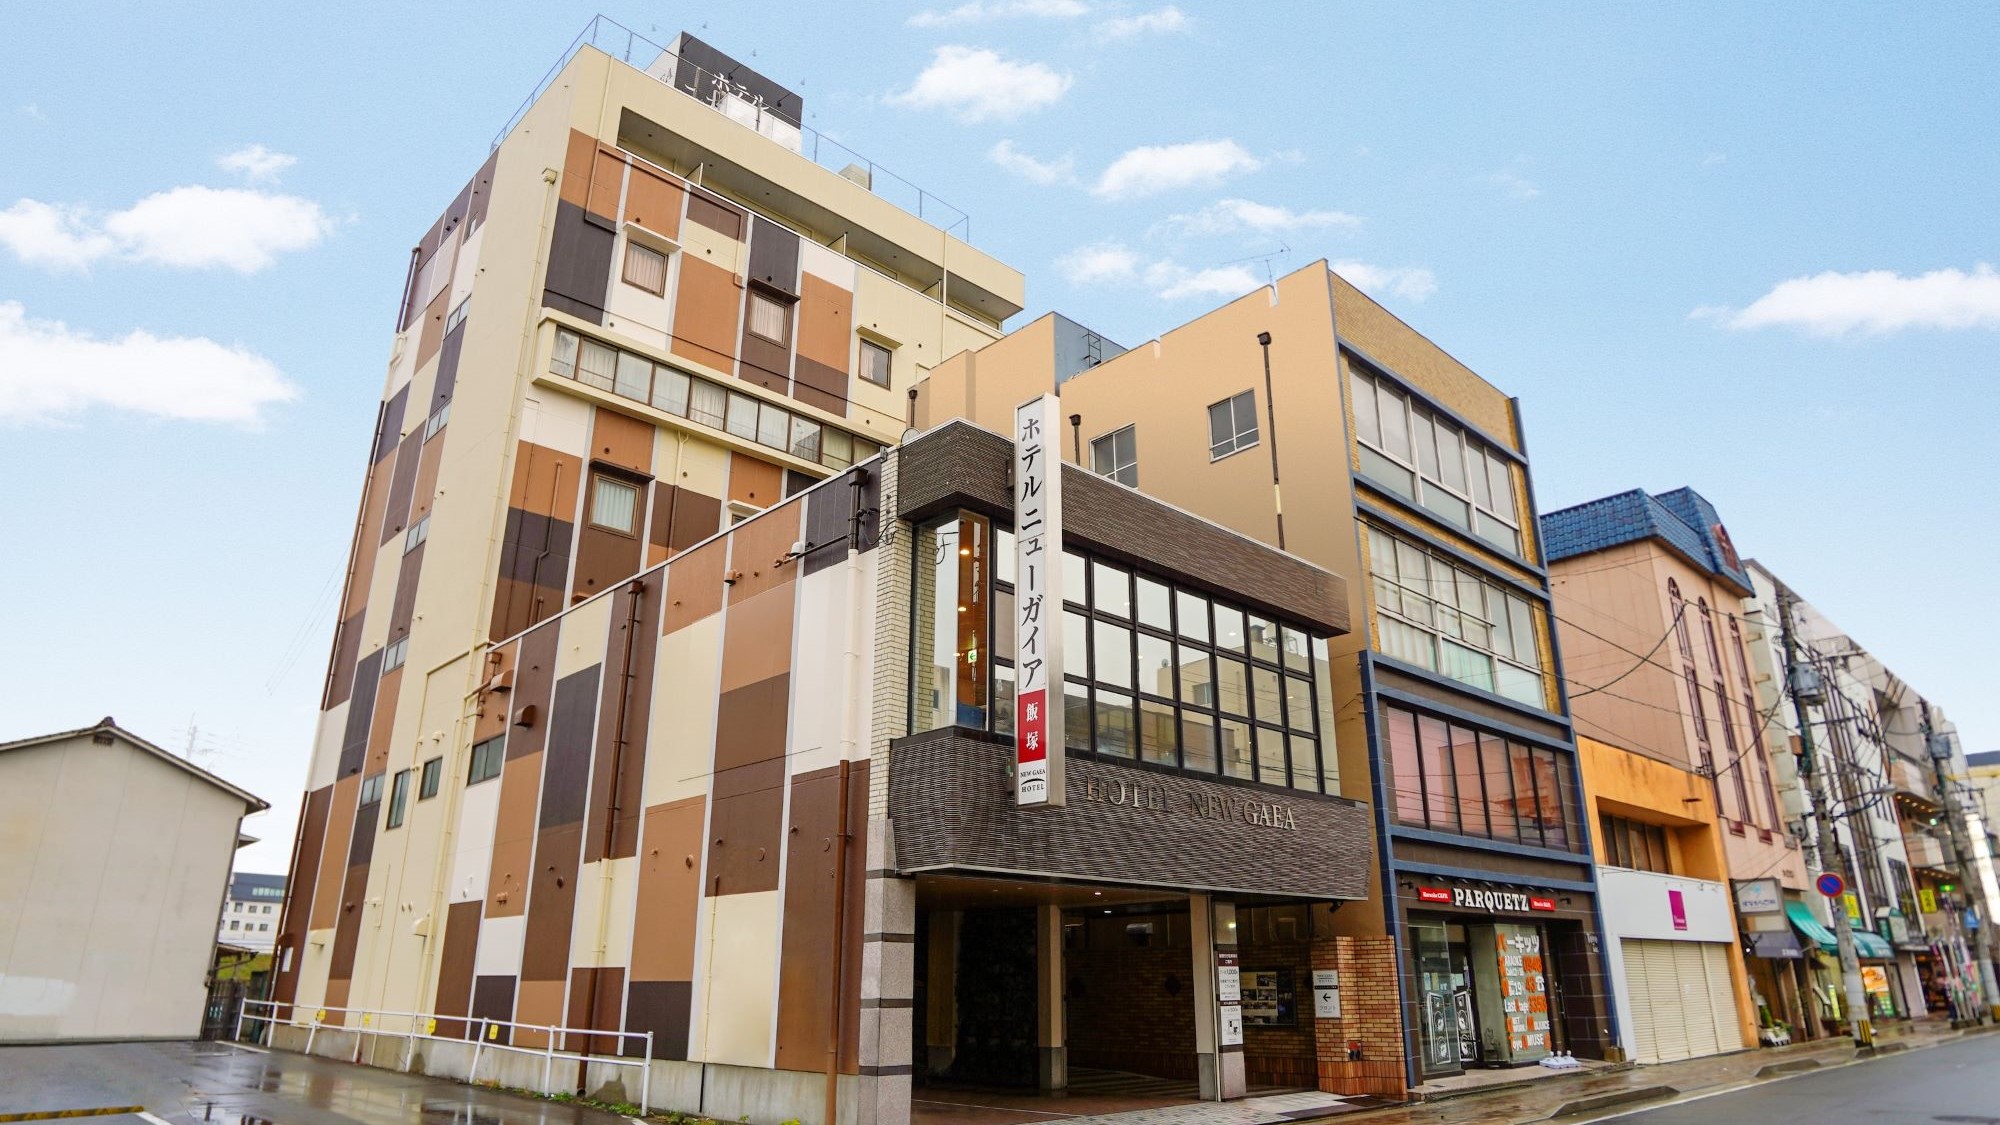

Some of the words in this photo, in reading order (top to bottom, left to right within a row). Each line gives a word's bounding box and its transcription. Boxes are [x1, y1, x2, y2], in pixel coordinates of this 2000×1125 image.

[1021, 418, 1043, 688] ホテルニューガイア
[1026, 702, 1039, 751] 飯塚
[1020, 770, 1032, 778] NEW
[1032, 768, 1046, 777] GAEA
[1021, 783, 1045, 793] HOTEL
[1085, 775, 1174, 814] HOTEL
[1188, 790, 1237, 823] NEW
[1243, 799, 1297, 831] GAEA
[1453, 887, 1530, 913] PARQUETZ
